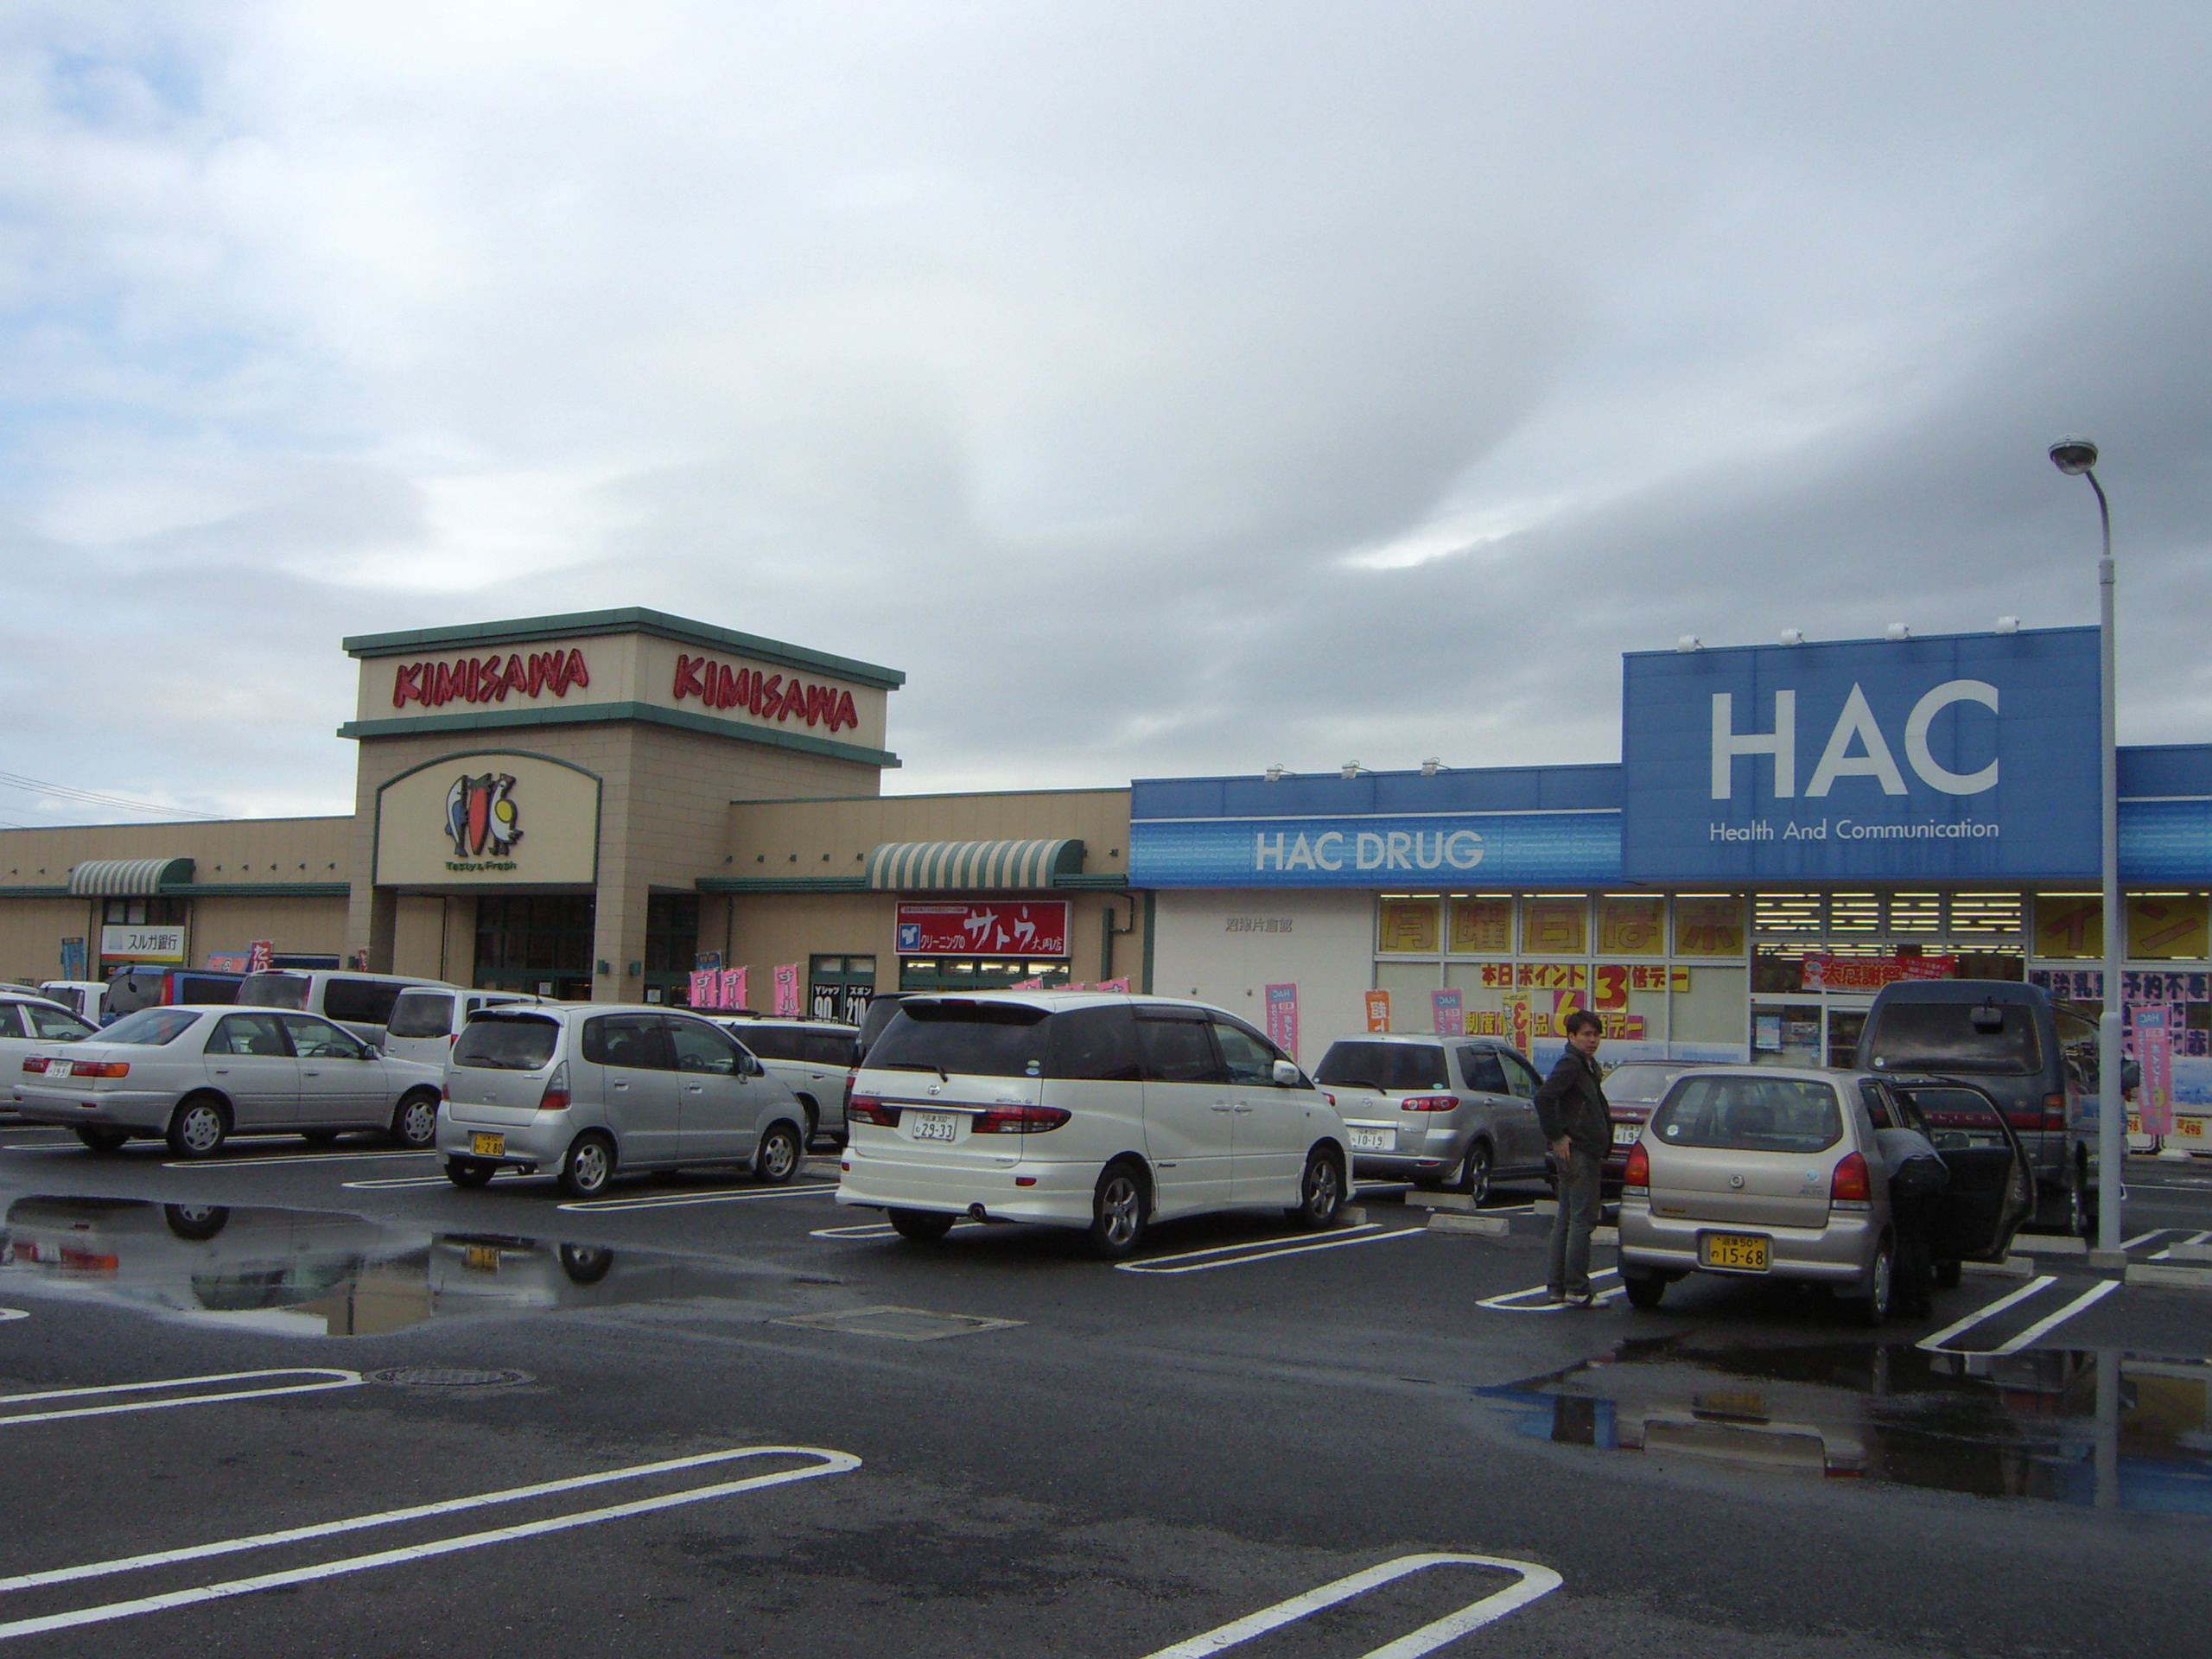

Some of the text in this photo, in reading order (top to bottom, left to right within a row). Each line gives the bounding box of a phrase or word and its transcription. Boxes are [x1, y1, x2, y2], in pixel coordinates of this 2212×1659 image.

[393, 648, 589, 708] KIMISAWA
[673, 653, 858, 732] KIMISAWA
[1711, 679, 1999, 799] HAC
[1710, 817, 1999, 842] Health And Communication
[1255, 830, 1484, 871] HAC DRUG
[128, 934, 178, 950] スルガ銀行
[963, 906, 1036, 952] サトウ
[921, 1123, 953, 1138] 29-33
[1722, 1248, 1764, 1265] 15-68
